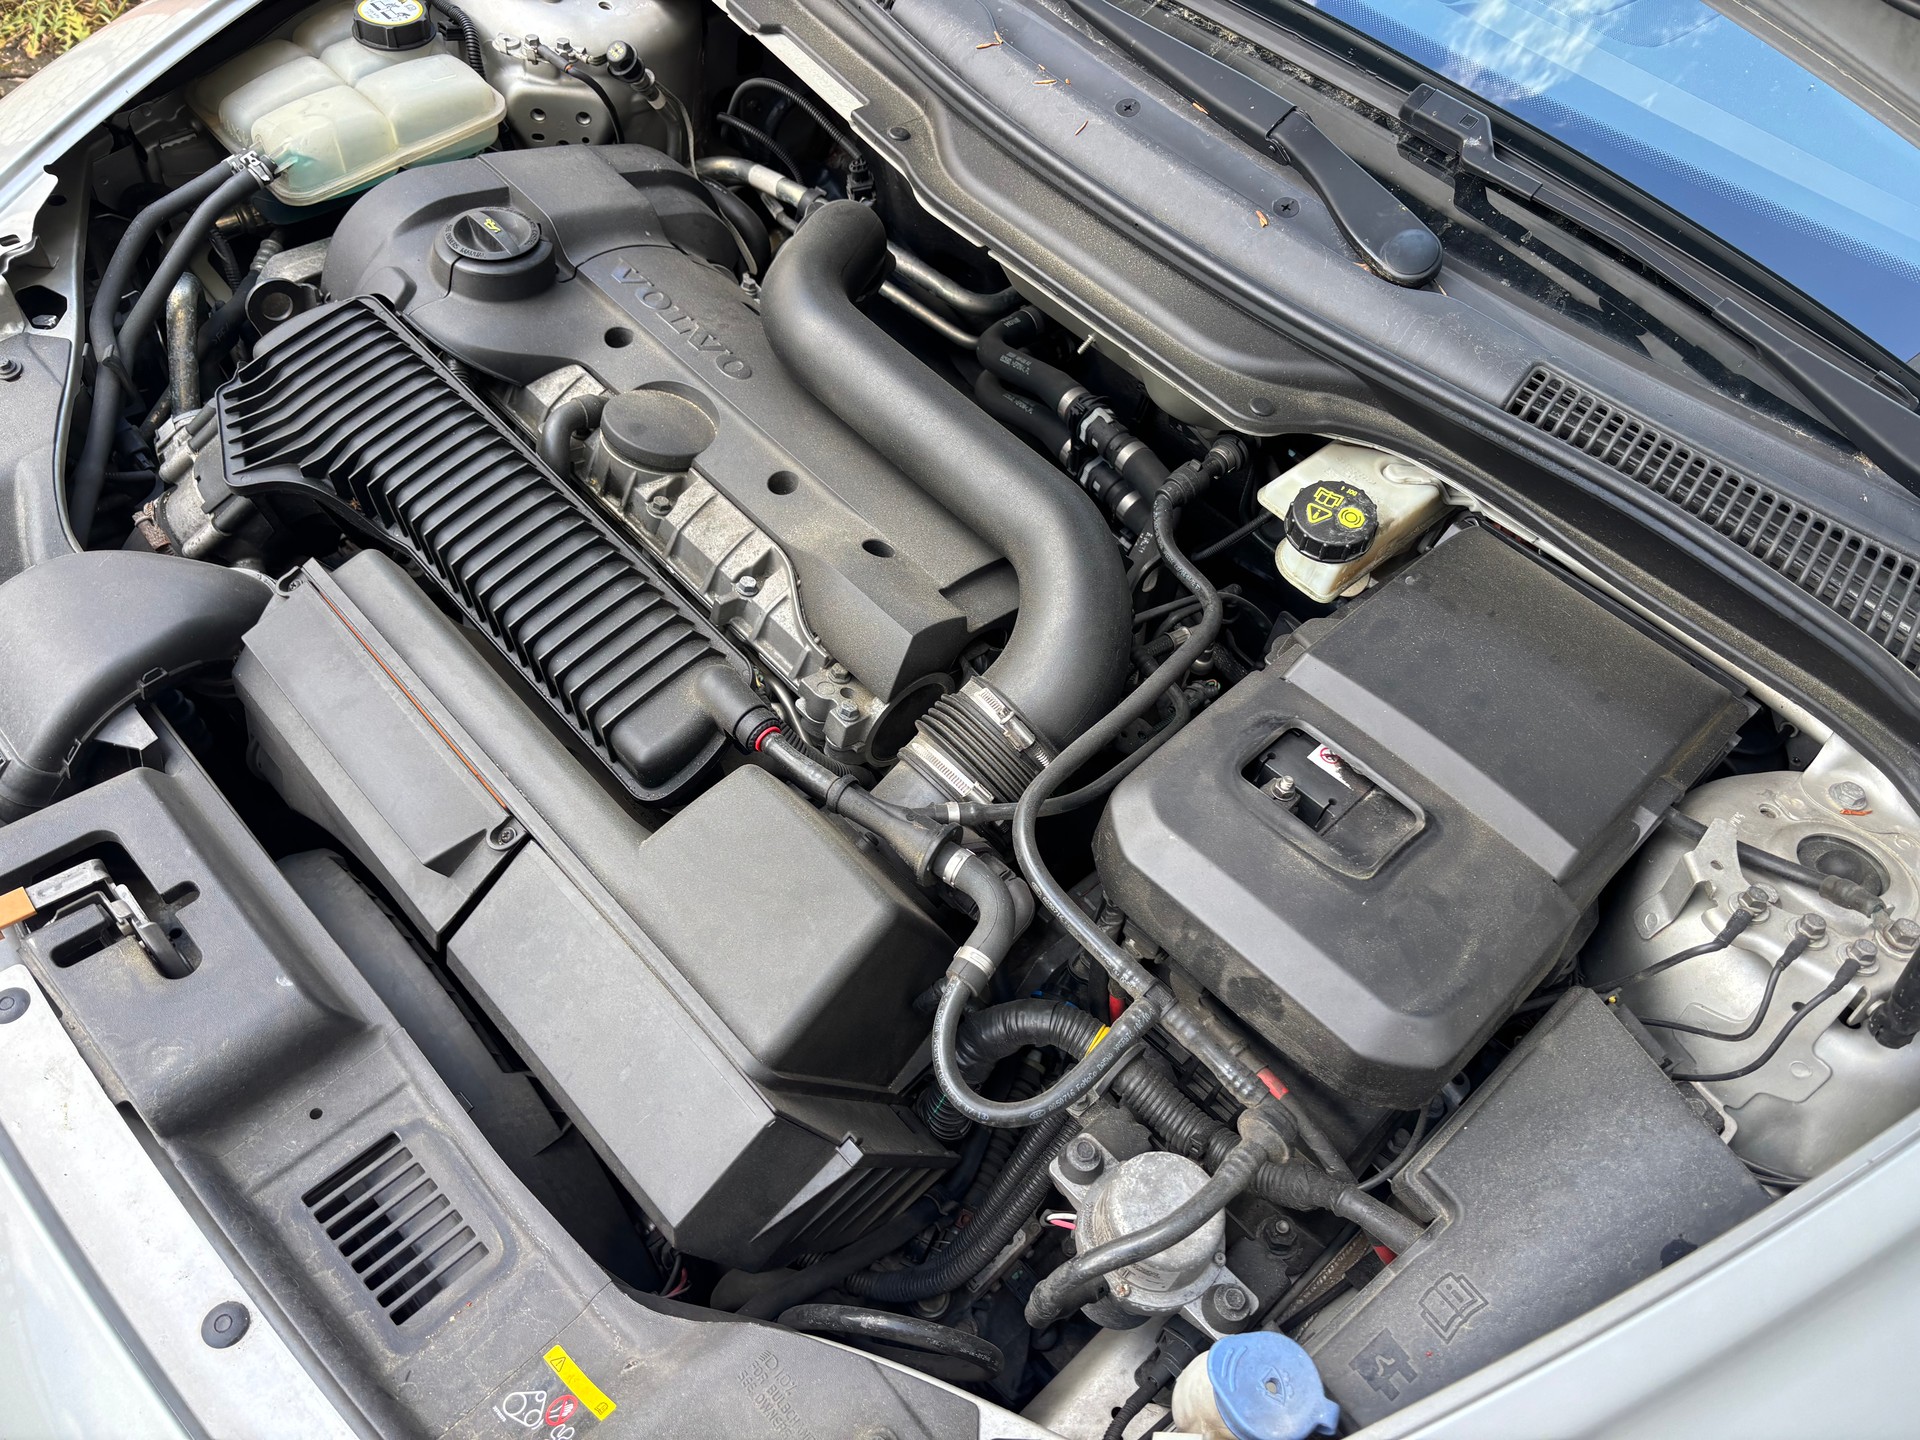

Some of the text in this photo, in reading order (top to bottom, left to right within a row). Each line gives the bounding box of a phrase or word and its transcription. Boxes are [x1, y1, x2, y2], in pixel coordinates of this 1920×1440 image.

[610, 257, 753, 381] VOLVO
[737, 1370, 758, 1393] SEE
[752, 1360, 769, 1384] FOR
